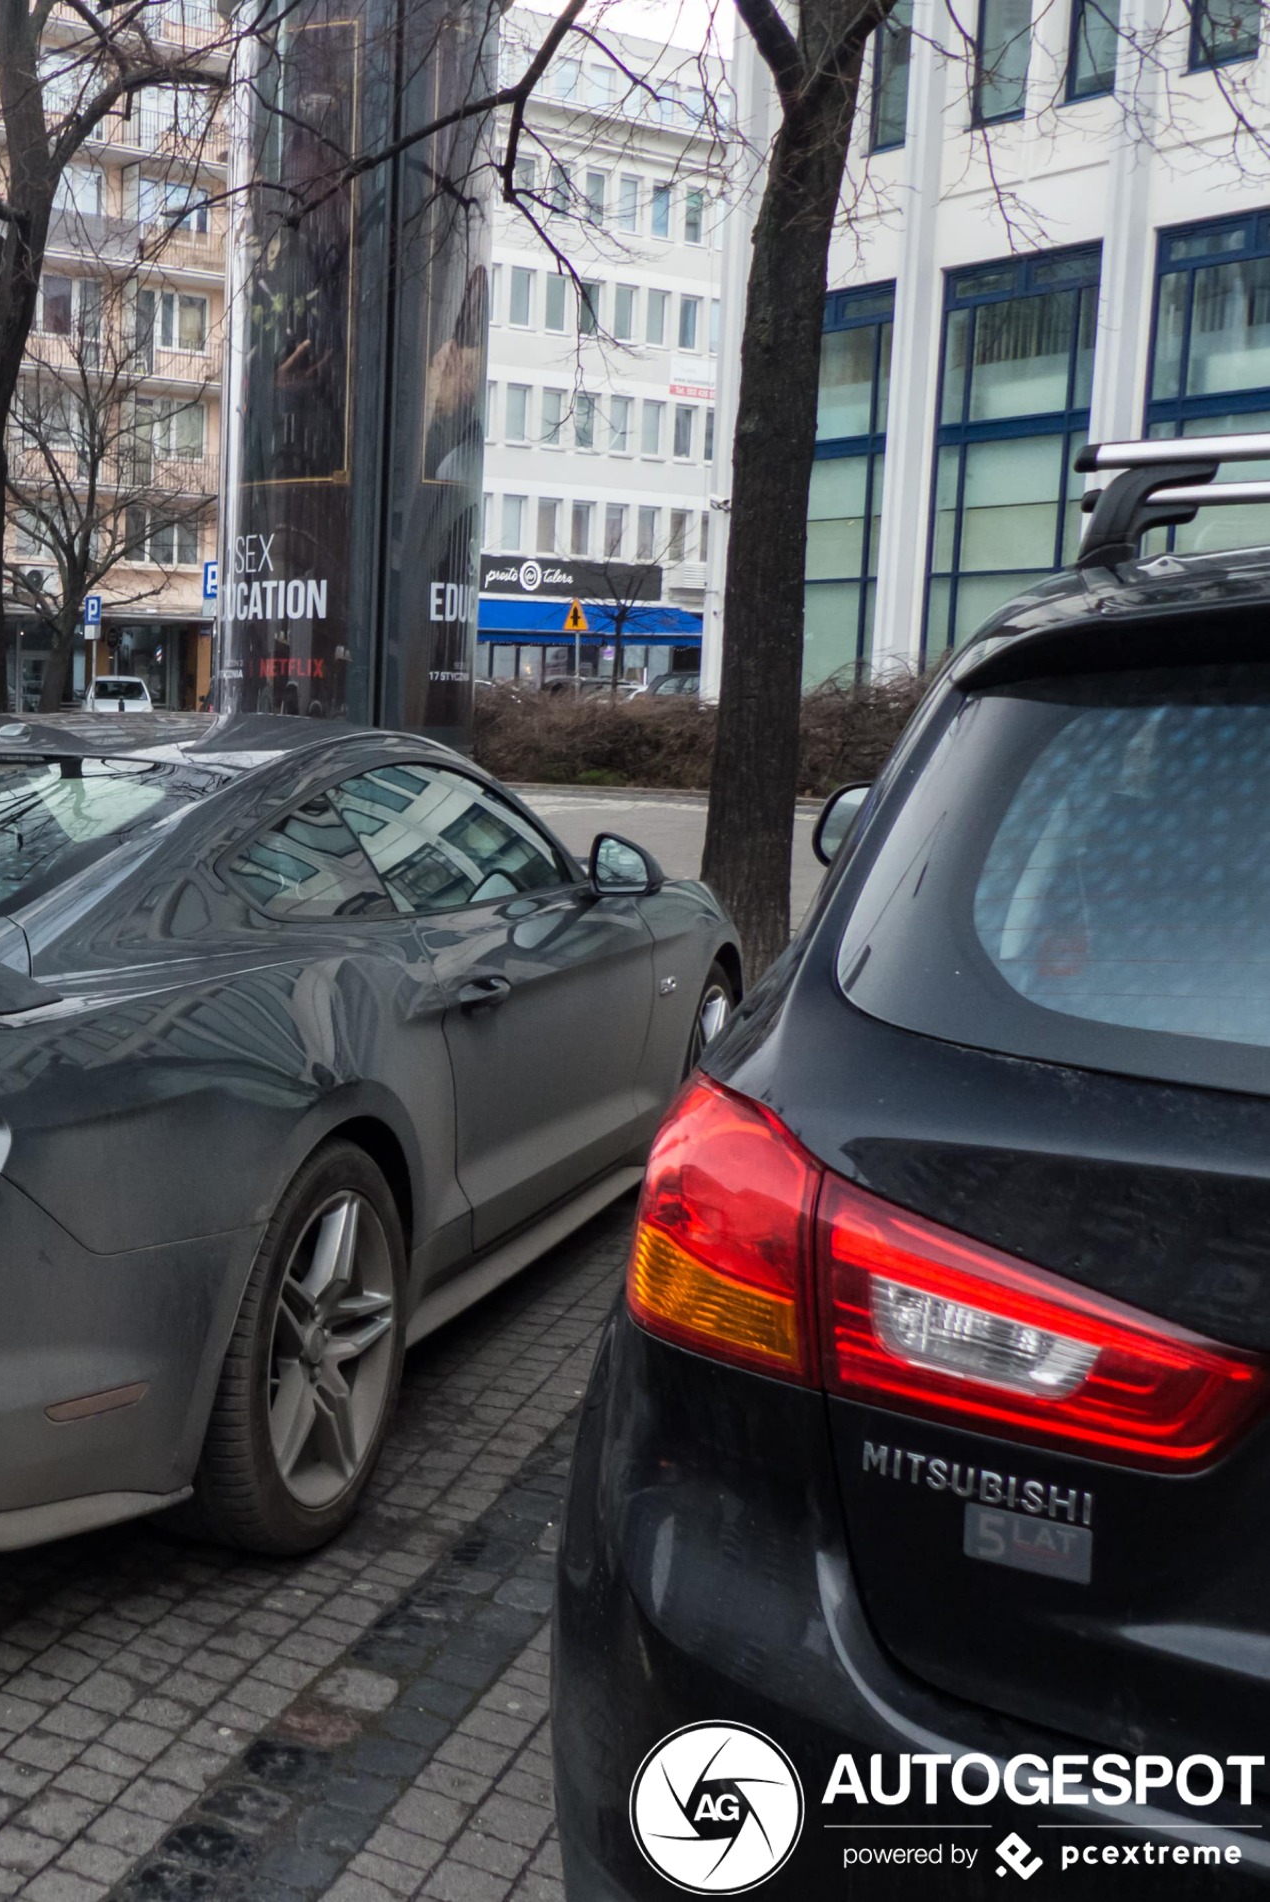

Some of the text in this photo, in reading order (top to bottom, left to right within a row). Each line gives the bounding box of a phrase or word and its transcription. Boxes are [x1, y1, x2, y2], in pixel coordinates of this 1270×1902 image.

[235, 533, 275, 573] SEX
[88, 599, 98, 622] P
[259, 658, 324, 679] NETFLIX
[862, 1440, 1093, 1526] MITSUBISHI
[977, 1512, 1079, 1558] 5 LAT
